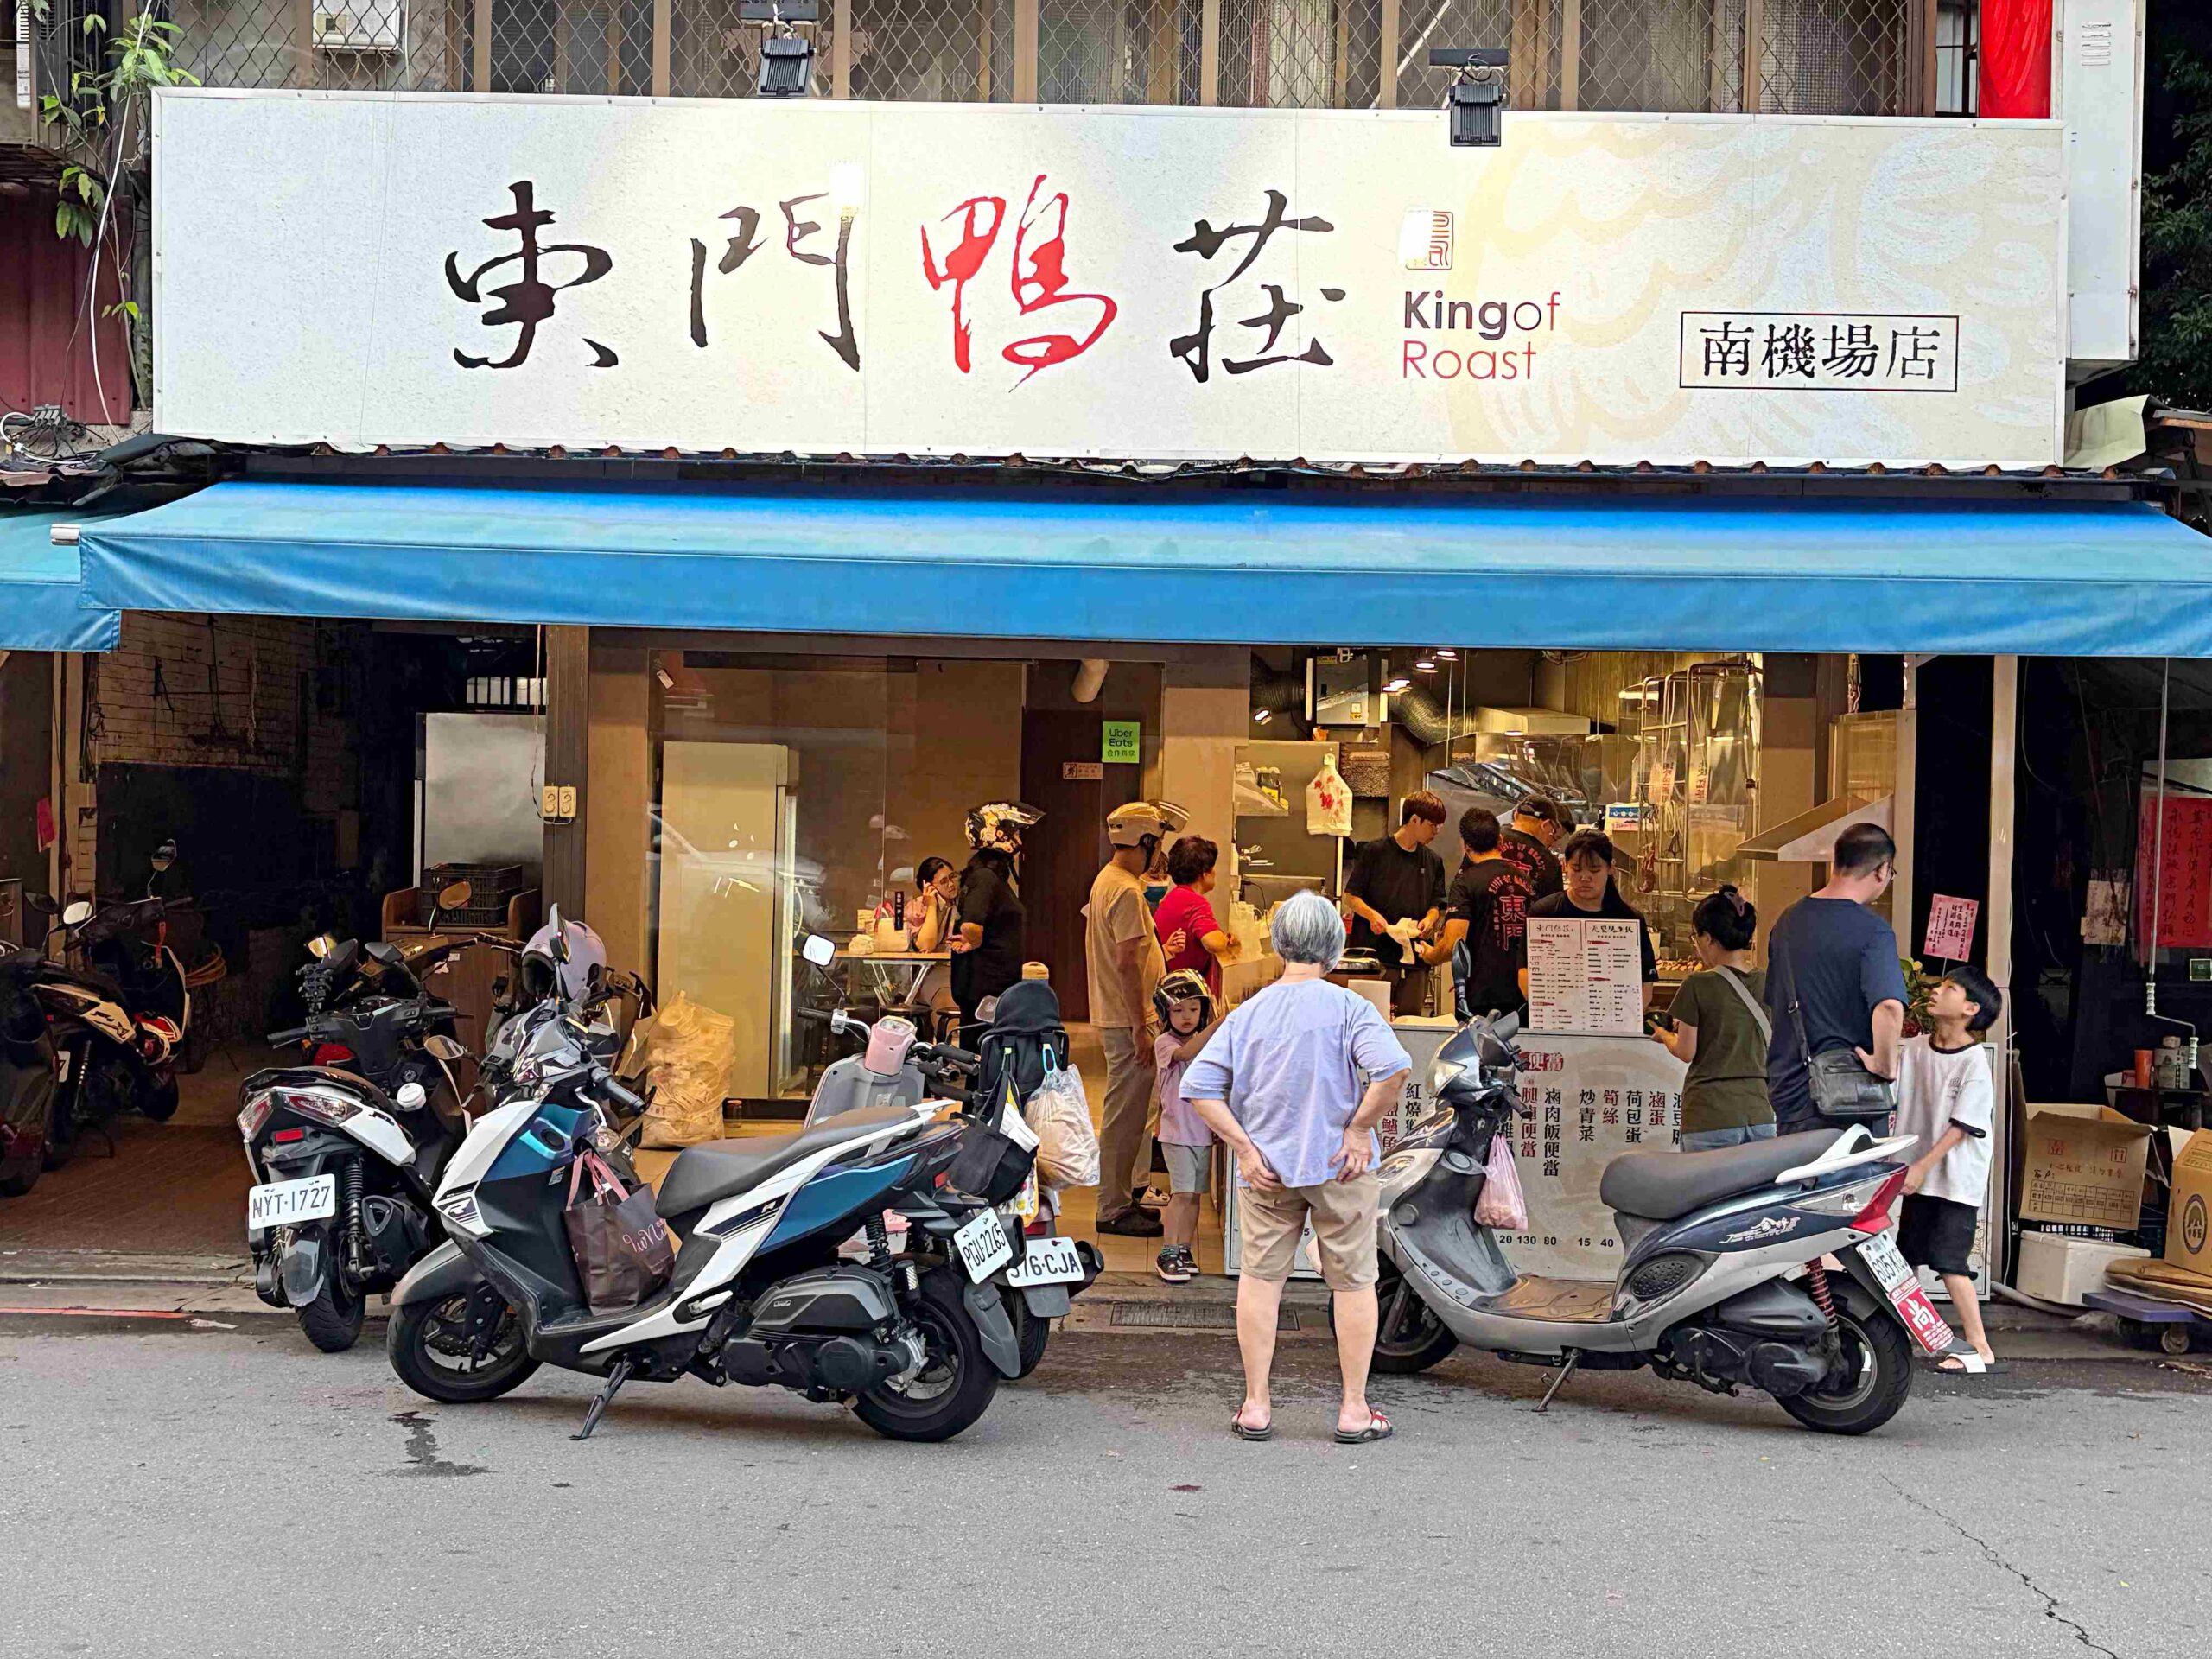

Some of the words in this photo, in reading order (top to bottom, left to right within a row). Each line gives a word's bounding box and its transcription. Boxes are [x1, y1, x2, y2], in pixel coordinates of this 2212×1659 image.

[1403, 340, 1536, 380] Roast
[1700, 321, 1940, 379] 南機場店
[1109, 728, 1133, 737] Uber
[1109, 738, 1133, 747] Eats
[1499, 894, 1527, 951] 東門
[1578, 1089, 1596, 1142] 炒青菜
[1602, 1090, 1618, 1124] 筍絲
[1625, 1090, 1642, 1143] 荷包蛋
[1649, 1091, 1666, 1126] 滷蛋
[1543, 1088, 1561, 1177] 滷肉飯便當
[1517, 1234, 1536, 1245] 130
[1544, 1236, 1557, 1246] 80
[1579, 1237, 1591, 1247] 15
[1600, 1237, 1614, 1248] 40
